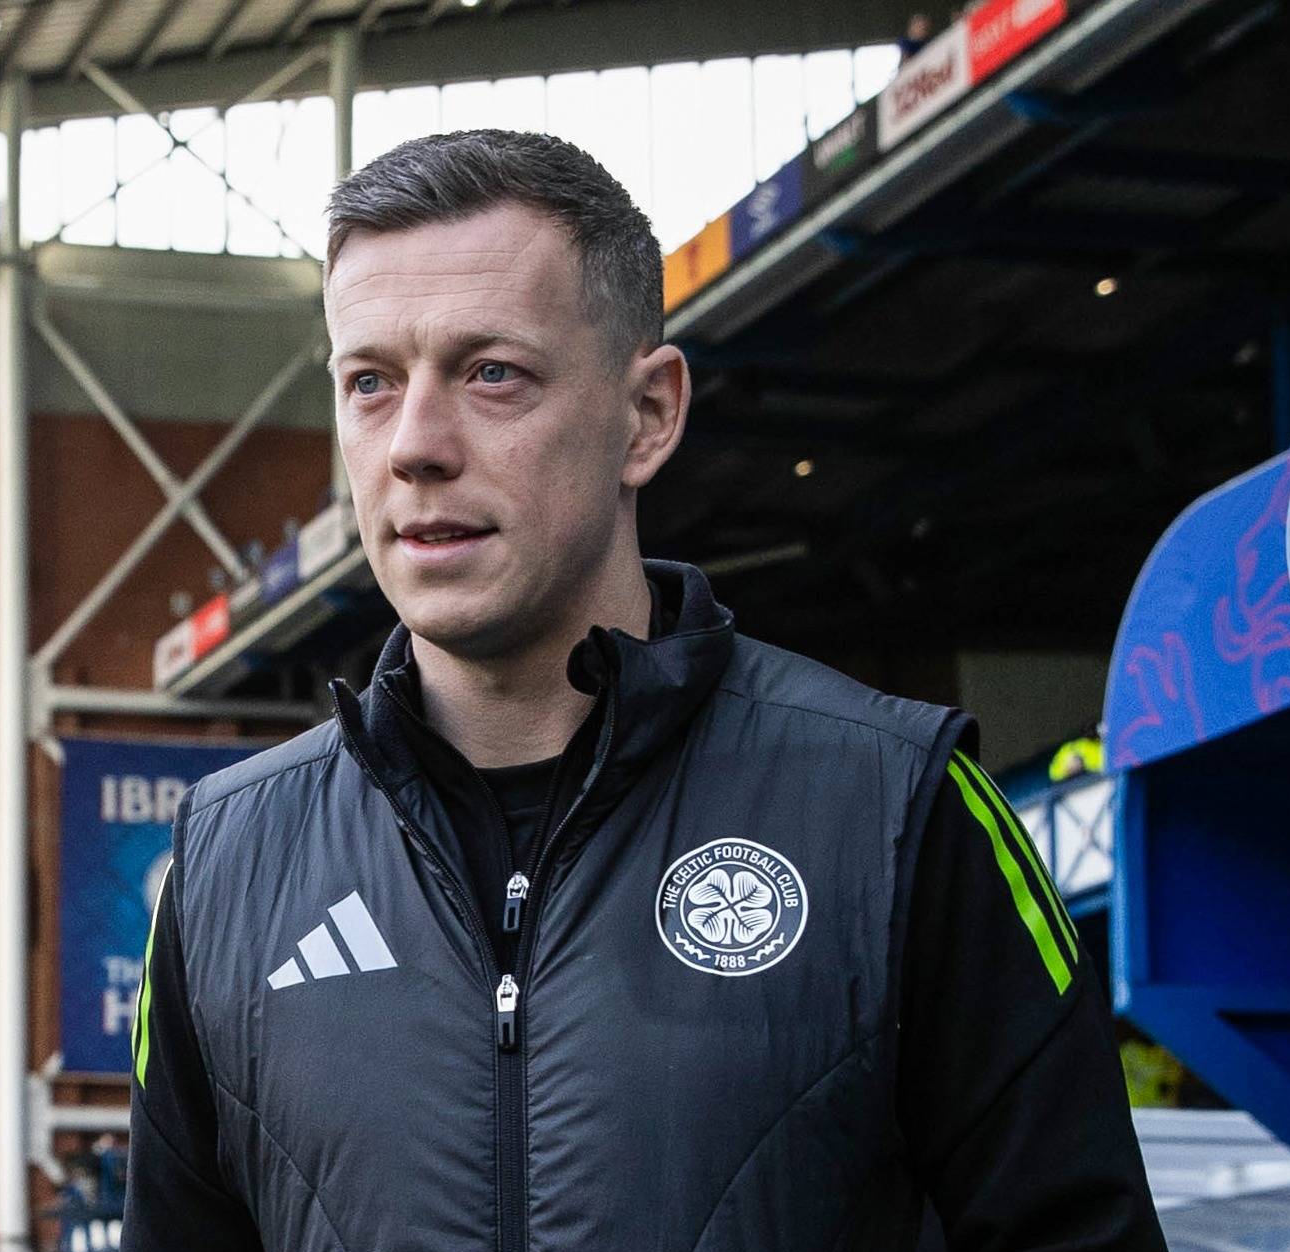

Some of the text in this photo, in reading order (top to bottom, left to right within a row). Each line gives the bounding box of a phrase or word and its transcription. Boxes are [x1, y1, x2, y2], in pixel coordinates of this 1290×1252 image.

[102, 775, 187, 823] IBR
[663, 845, 799, 909] THE CELTIC FOOTBALL CLUB
[714, 953, 747, 968] 1888
